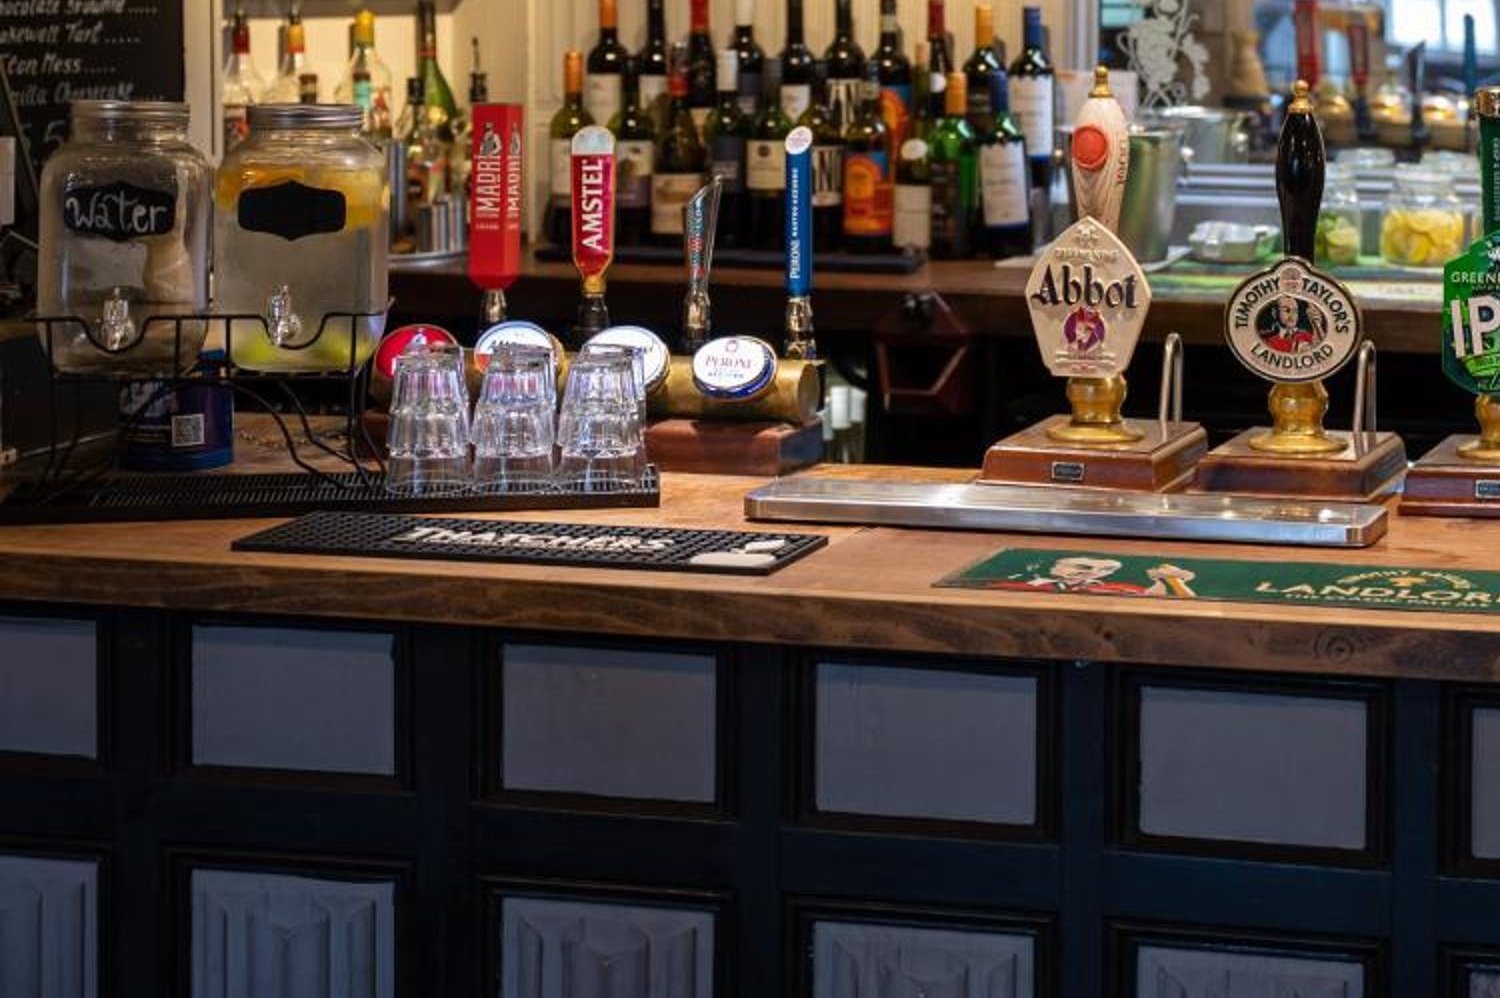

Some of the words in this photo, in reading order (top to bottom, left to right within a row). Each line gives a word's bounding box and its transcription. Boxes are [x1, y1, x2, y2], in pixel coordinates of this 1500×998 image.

[66, 17, 103, 45] Tart
[42, 52, 82, 76] Mess
[64, 188, 168, 234] Water
[581, 158, 604, 251] AMSTEL
[1030, 263, 1138, 308] Abbot
[1234, 277, 1281, 330] TIMOTHY
[1251, 343, 1333, 369] LANDLORD
